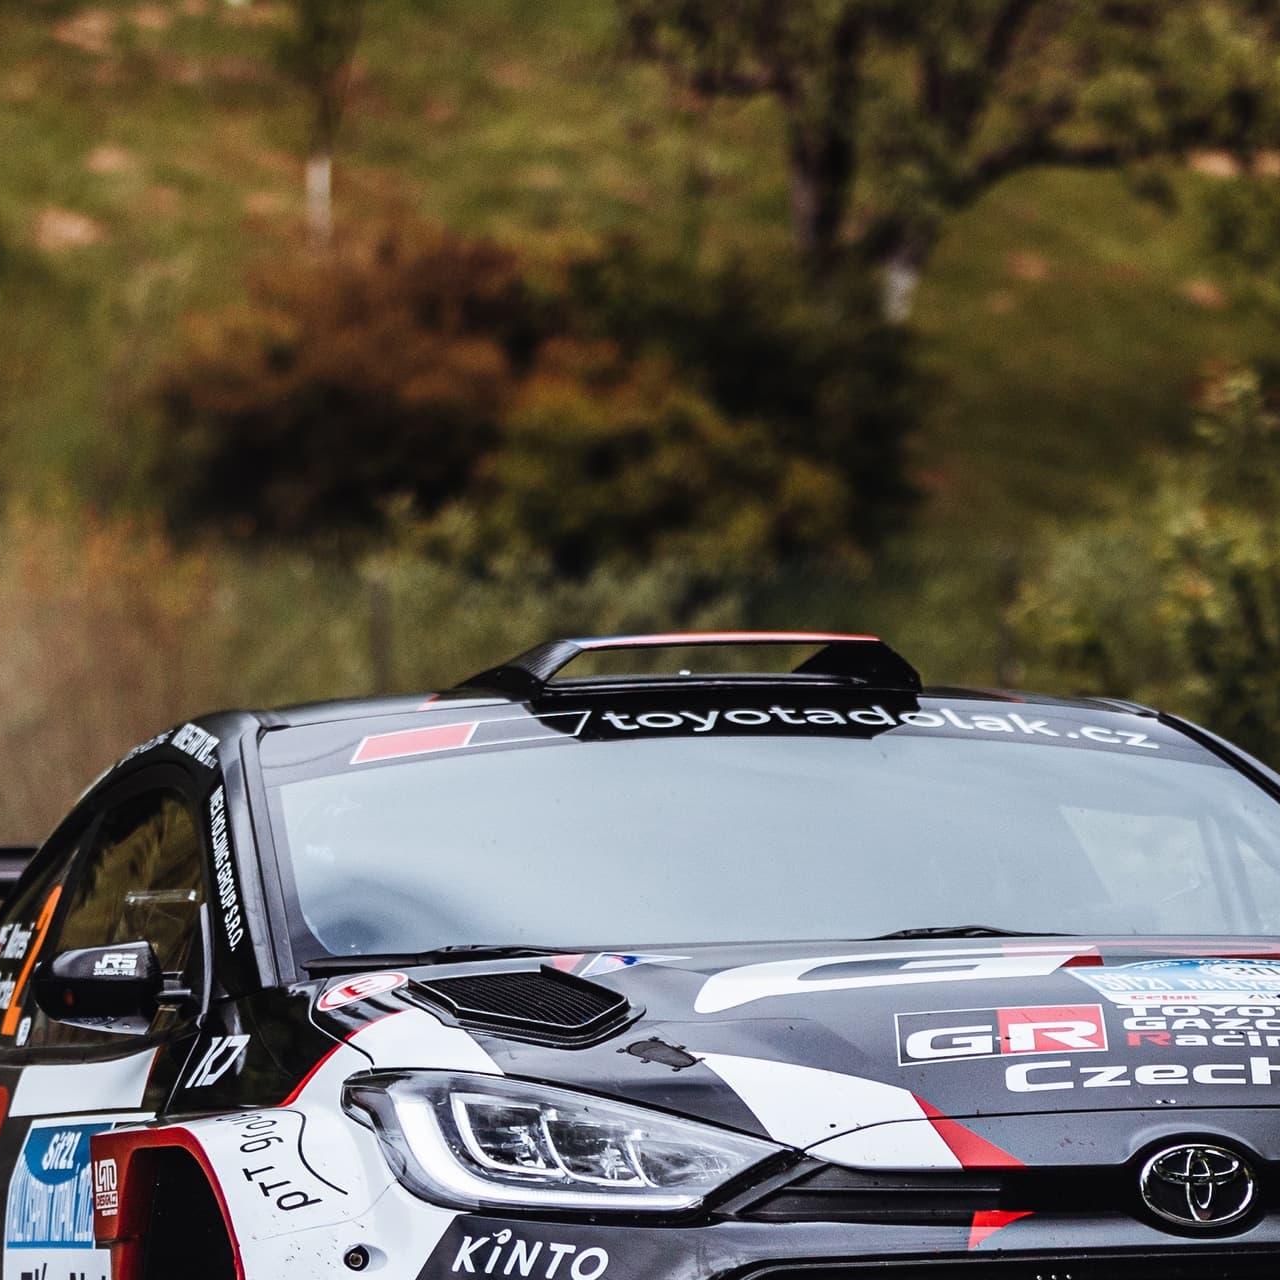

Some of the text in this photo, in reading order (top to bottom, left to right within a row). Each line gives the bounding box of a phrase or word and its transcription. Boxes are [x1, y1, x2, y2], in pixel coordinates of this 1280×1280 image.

[603, 704, 1159, 750] toyotadolak.cz
[217, 861, 238, 909] GROUP
[95, 953, 138, 969] JRS
[906, 1019, 1098, 1059] GR
